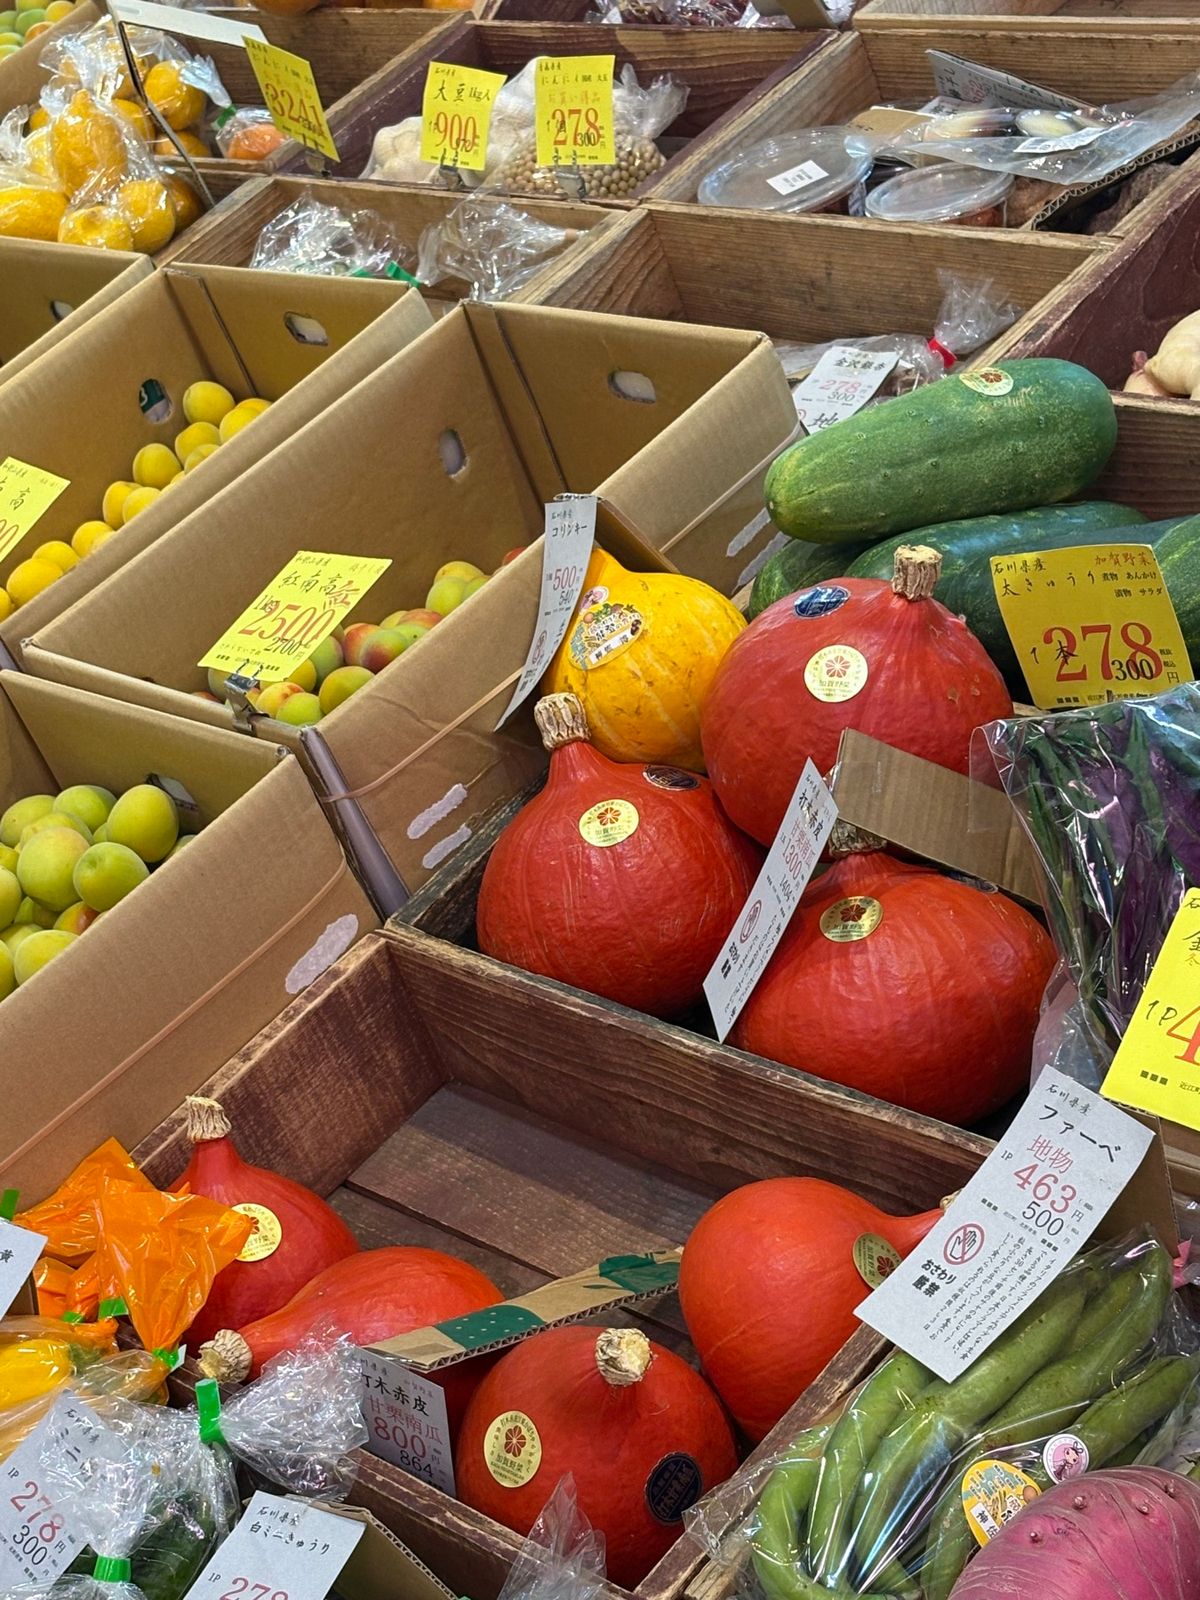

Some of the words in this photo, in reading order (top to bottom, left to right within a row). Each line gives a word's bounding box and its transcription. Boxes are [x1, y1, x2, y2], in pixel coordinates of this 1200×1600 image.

[434, 111, 477, 153] 900
[551, 107, 601, 147] 278
[576, 131, 597, 147] 300
[819, 379, 862, 394] 278
[827, 391, 856, 402] 300
[552, 522, 588, 538] コリンキー
[993, 558, 1047, 576] 石川県産
[1094, 551, 1151, 568] 加賀野菜
[553, 565, 577, 591] 500
[1001, 569, 1095, 597] 太きゅうり
[1138, 587, 1163, 597] サラダ
[237, 600, 336, 641] 2500
[263, 635, 303, 657] 2700
[1042, 622, 1163, 683] 278
[1110, 658, 1154, 681] 300
[1166, 671, 1180, 684] 円
[781, 838, 803, 880] 1300
[779, 873, 793, 902] 1404
[1044, 1083, 1093, 1117] 石川県産
[1038, 1103, 1122, 1164] ファーベ
[1026, 1134, 1074, 1175] 地物
[1013, 1162, 1077, 1214] 463
[1070, 1208, 1085, 1223] 円
[1021, 1200, 1064, 1236] 500
[920, 1258, 957, 1285] おさわり
[911, 1274, 942, 1298] 厳禁
[374, 1416, 427, 1459] 800
[7, 1467, 20, 1479] 1P
[400, 1449, 434, 1478] 864
[9, 1481, 66, 1543] 278
[12, 1524, 48, 1566] 300
[55, 1540, 67, 1554] 円
[249, 1520, 331, 1555] 白ミニきゅうり
[208, 1572, 222, 1583] 1P
